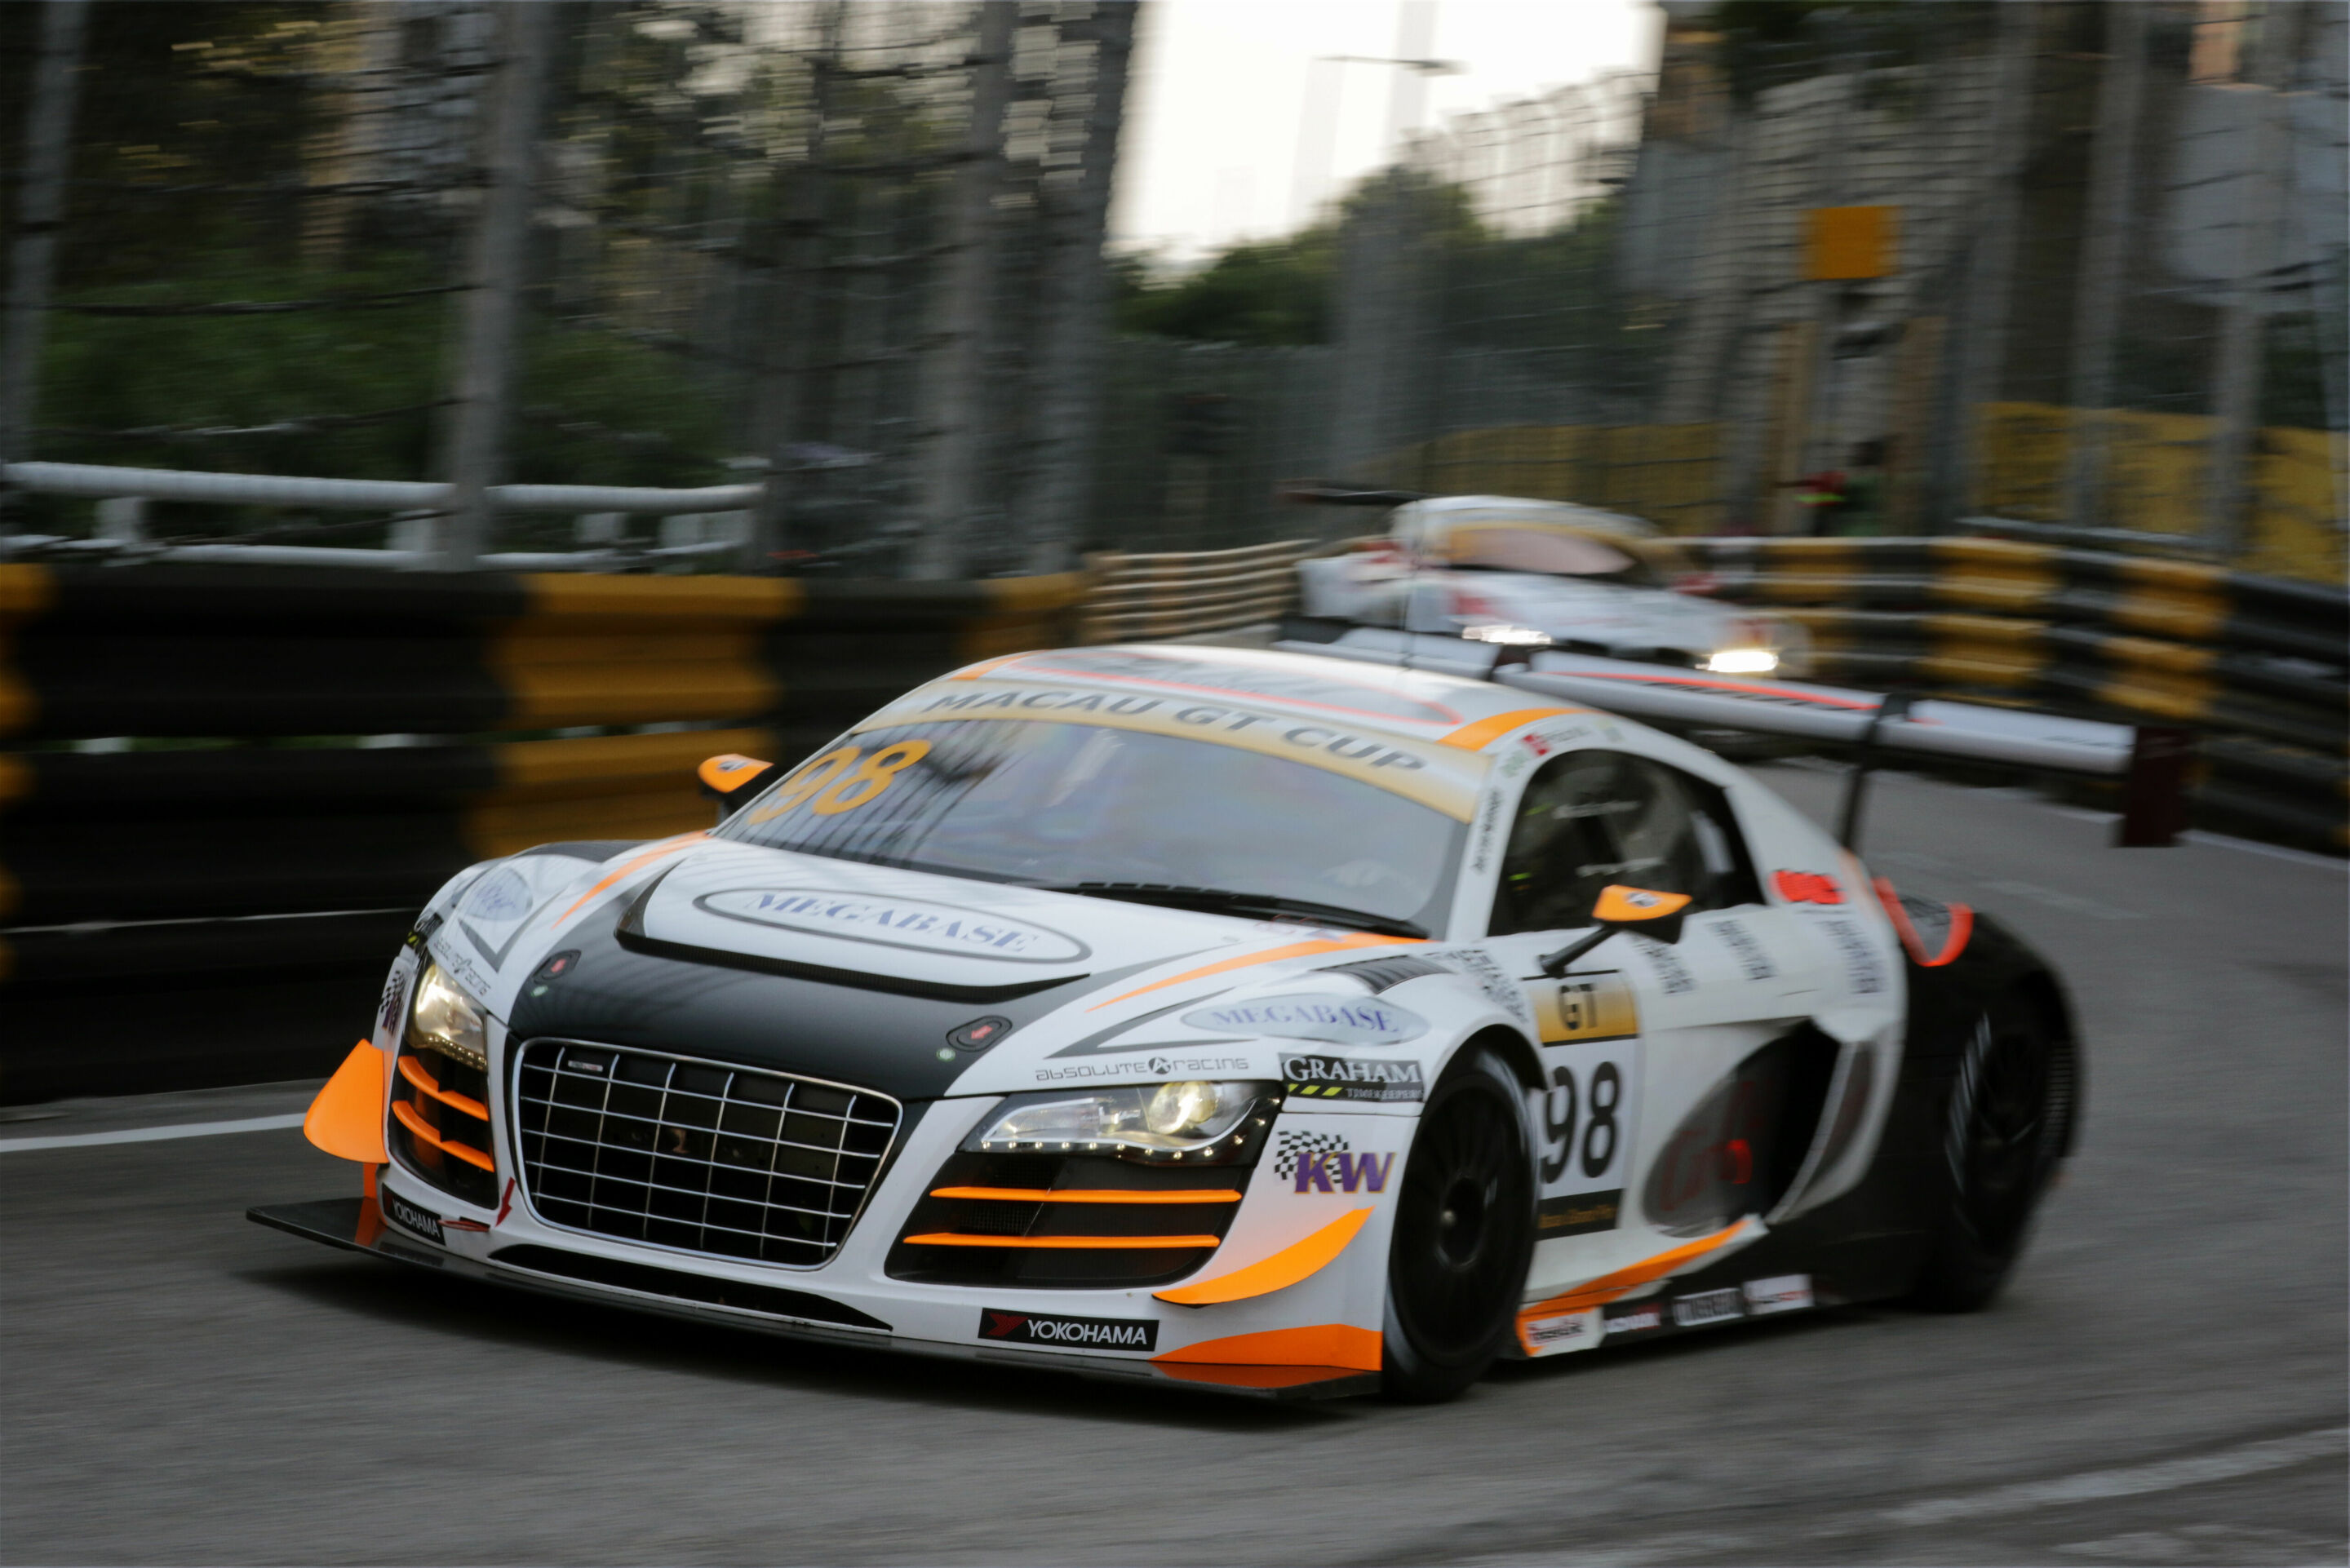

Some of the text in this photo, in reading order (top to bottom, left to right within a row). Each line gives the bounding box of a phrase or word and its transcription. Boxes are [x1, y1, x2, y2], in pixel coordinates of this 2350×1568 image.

[920, 691, 1428, 769] MACAU GT CUP
[747, 739, 932, 826] 98
[743, 893, 1040, 952] MEGABASE
[1212, 1004, 1399, 1033] MEGABASE
[1558, 982, 1598, 1030] GT
[1283, 1056, 1421, 1083] GRAHAM
[1540, 1061, 1621, 1185] 98
[1293, 1151, 1398, 1194] KW
[392, 1198, 440, 1238] YOKOHAMA
[1027, 1318, 1147, 1345] YOKOHAMA
